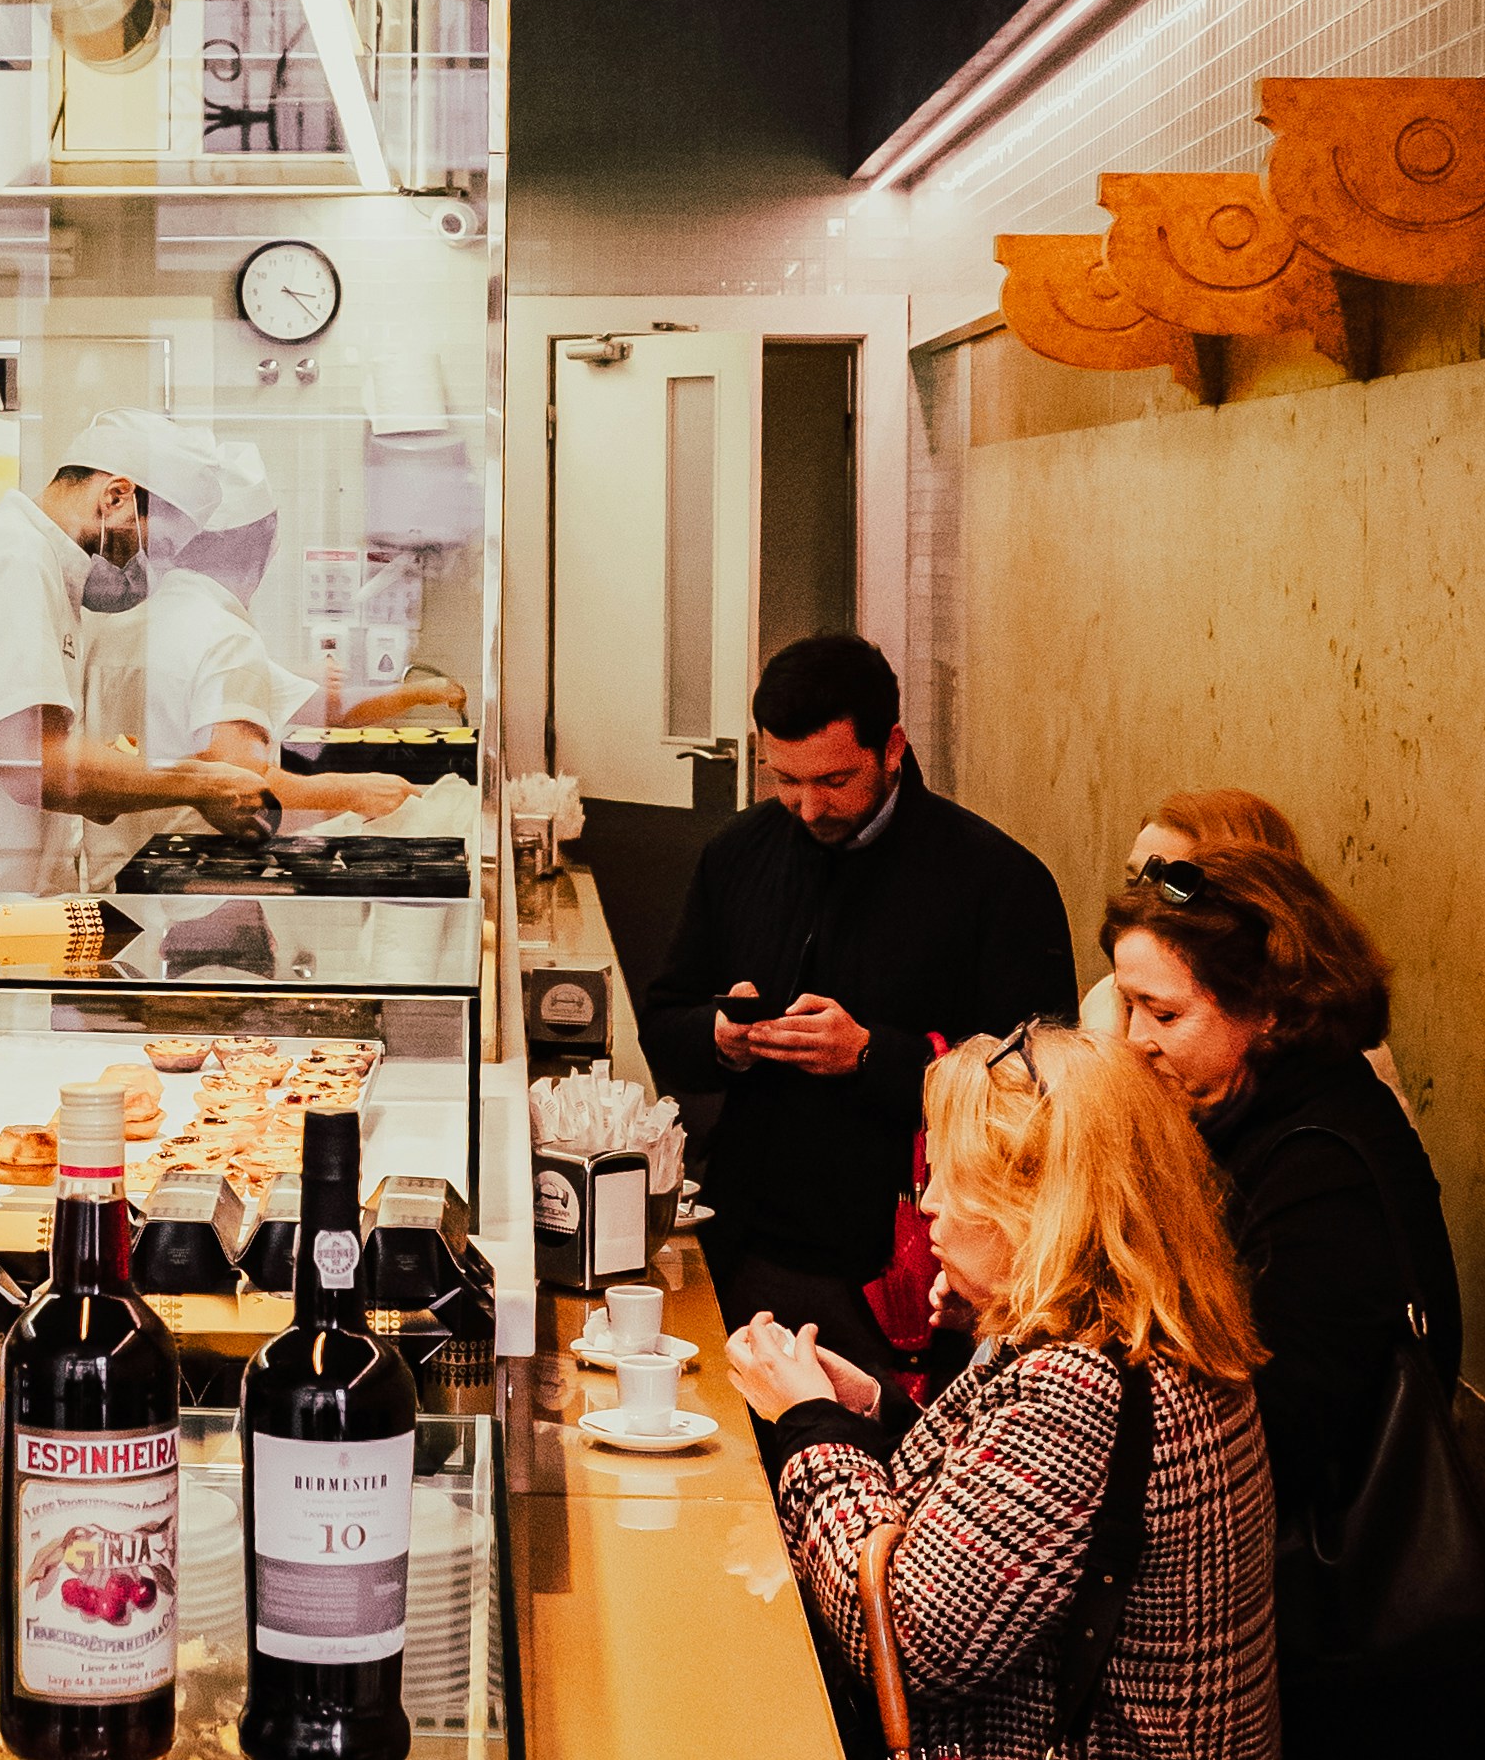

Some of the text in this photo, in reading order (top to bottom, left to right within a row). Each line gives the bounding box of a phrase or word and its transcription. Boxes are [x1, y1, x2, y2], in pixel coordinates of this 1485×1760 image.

[26, 1432, 180, 1475] ESPINHEIRA
[294, 1473, 388, 1492] BURMESTER
[65, 1533, 156, 1574] GINJA
[318, 1523, 367, 1554] 10
